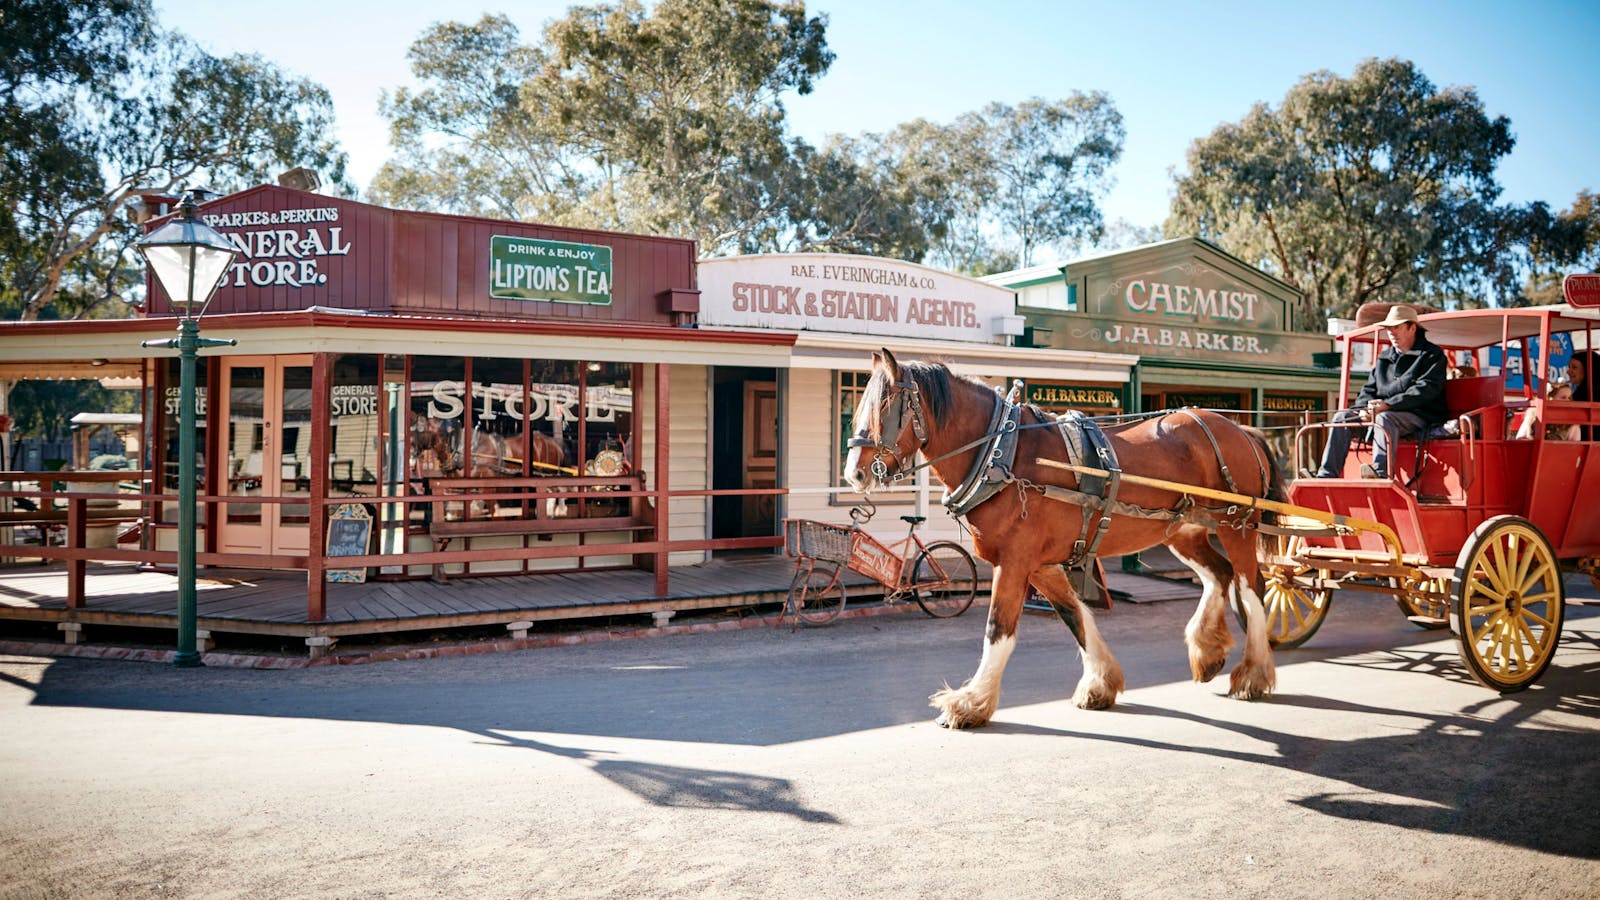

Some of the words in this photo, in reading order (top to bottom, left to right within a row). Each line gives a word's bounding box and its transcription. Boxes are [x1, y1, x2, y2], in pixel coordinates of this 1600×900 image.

[280, 207, 338, 224] PERKINS
[220, 227, 351, 258] NERAL
[508, 244, 546, 256] DRINK
[548, 248, 556, 256] &
[557, 248, 595, 260] ENJOY
[495, 258, 570, 292] LIPTON'S
[574, 265, 608, 295] TEA
[823, 265, 908, 287] EVERINGHAM
[909, 276, 918, 288] &
[920, 277, 937, 290] CO.
[732, 282, 802, 316] STOCK
[804, 292, 819, 317] &
[821, 289, 899, 323] STATION
[906, 297, 982, 329] AGENTS.
[1125, 280, 1259, 322] CHEMIST
[332, 385, 375, 396] GENERAL
[427, 380, 615, 423] STORE
[332, 396, 378, 416] STORE
